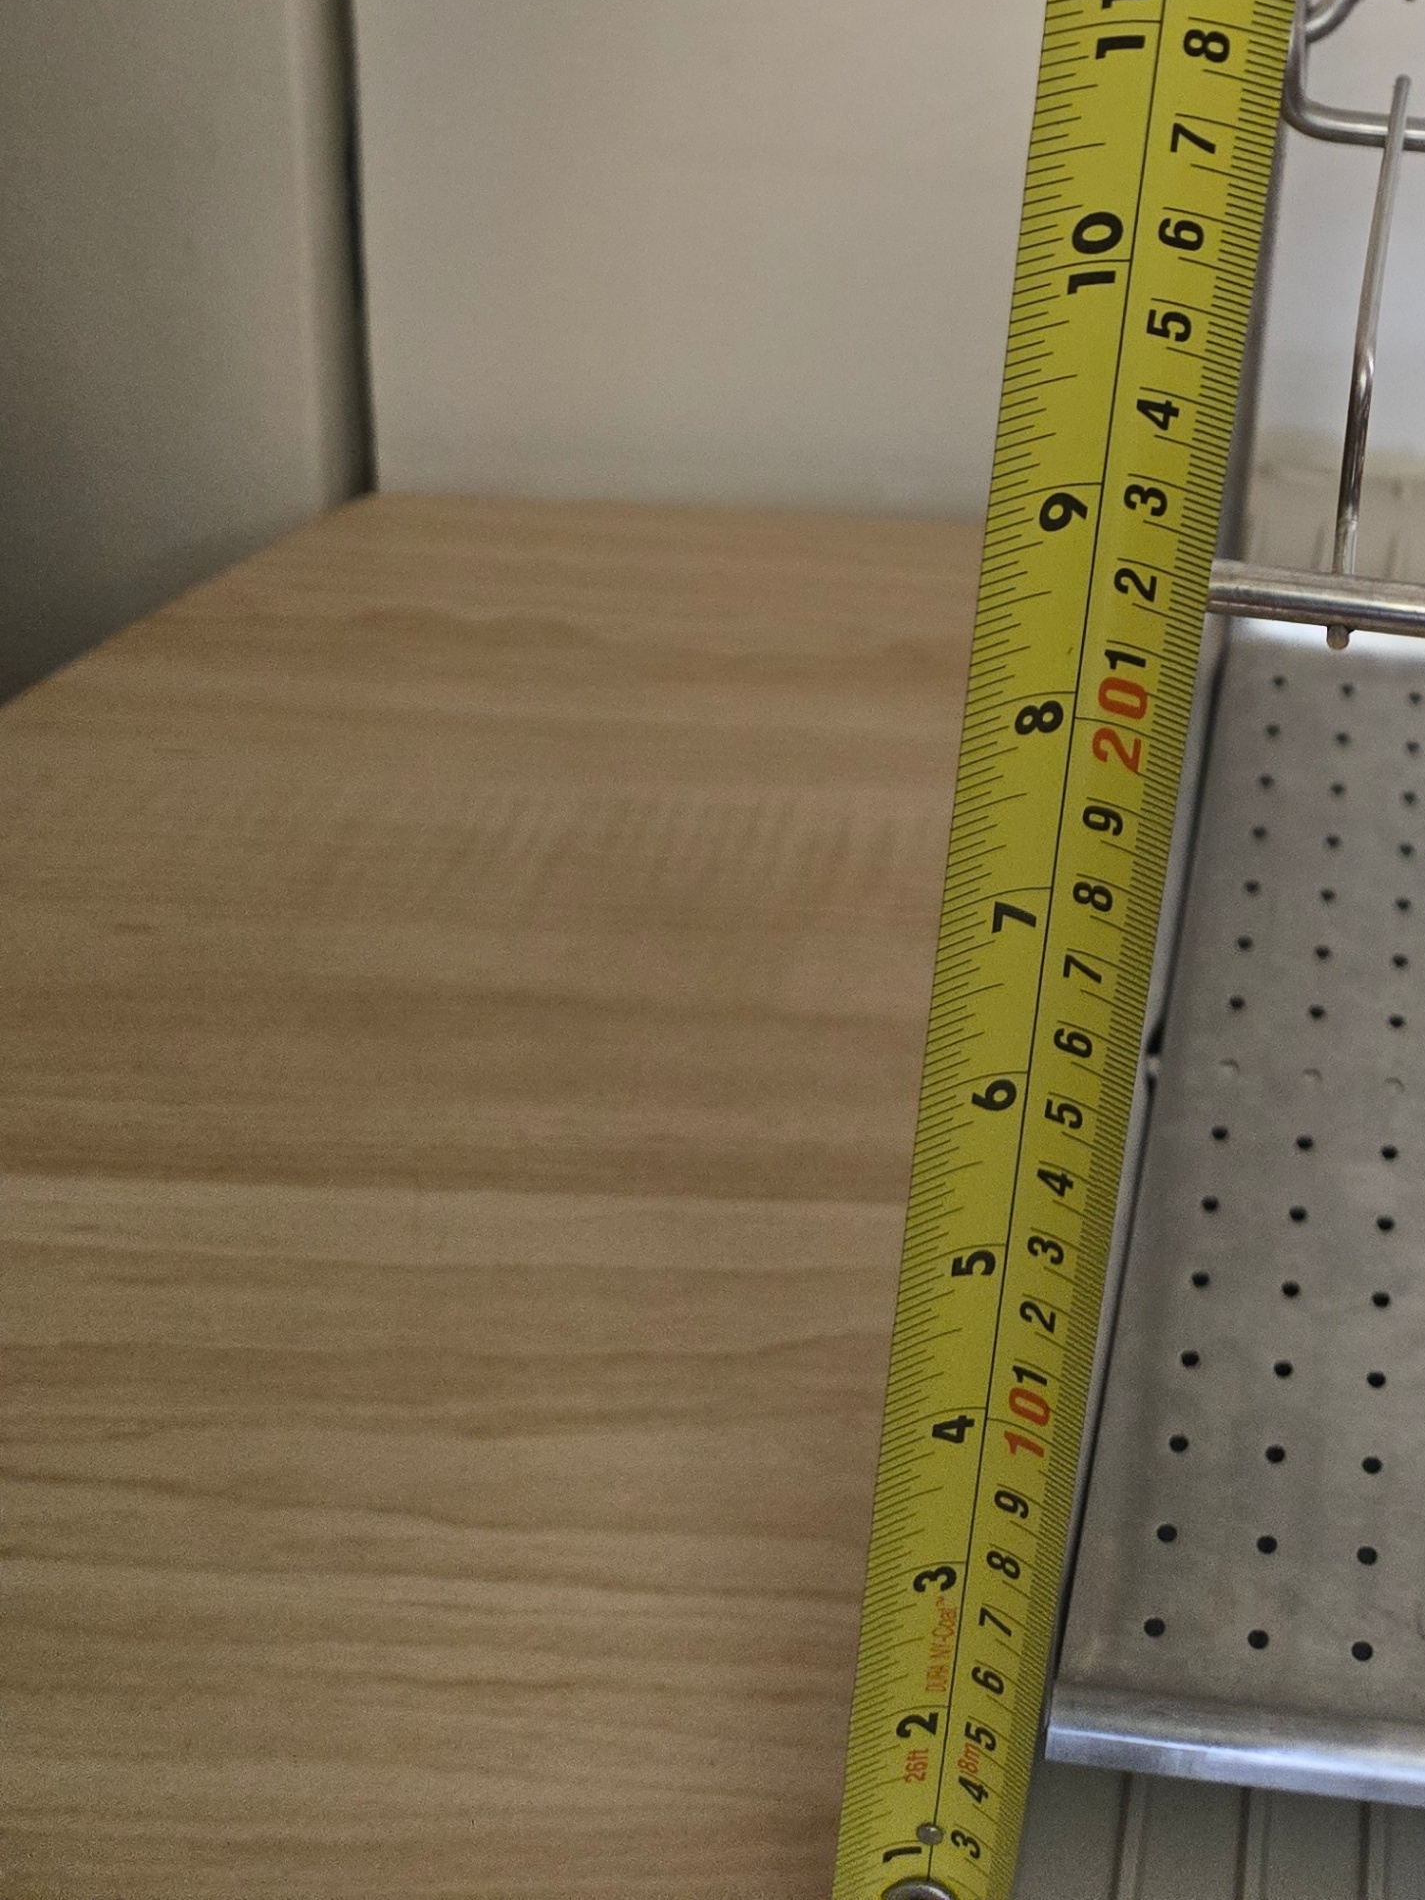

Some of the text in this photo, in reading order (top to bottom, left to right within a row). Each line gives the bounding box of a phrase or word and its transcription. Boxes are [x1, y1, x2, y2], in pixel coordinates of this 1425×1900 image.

[1183, 28, 1230, 64] 8
[1170, 122, 1216, 154] 7
[1158, 217, 1205, 252] 6
[1066, 211, 1124, 295] 10
[1146, 308, 1192, 343] 5
[1136, 398, 1180, 431] 4
[1039, 492, 1088, 532] 9
[1123, 483, 1168, 517] 3
[1113, 567, 1157, 603] 2
[1104, 648, 1146, 670] 1
[1014, 700, 1064, 735] 8
[1092, 676, 1148, 773] 20
[1082, 805, 1123, 836] 9
[1072, 881, 1113, 913] 8
[992, 901, 1037, 934] 7
[1063, 954, 1102, 984] 7
[1053, 1028, 1093, 1058] 6
[971, 1079, 1017, 1112] 6
[1044, 1098, 1083, 1130] 5
[1036, 1168, 1074, 1197] 4
[951, 1250, 996, 1277] 5
[1027, 1235, 1064, 1265] 3
[1019, 1300, 1056, 1334] 2
[1012, 1365, 1047, 1386] 1
[932, 1415, 975, 1444] 4
[1003, 1387, 1050, 1458] 10
[994, 1490, 1029, 1519] 9
[913, 1566, 957, 1593] 3
[986, 1550, 1021, 1579] 8
[978, 1607, 1012, 1637] 7
[971, 1666, 1005, 1695] 6
[896, 1712, 939, 1739] 2
[964, 1721, 997, 1751] 5
[904, 1748, 929, 1784] 26ft
[957, 1742, 981, 1776] 8m
[958, 1775, 989, 1804] 4
[883, 1846, 922, 1863] 1
[951, 1829, 981, 1860] 3
